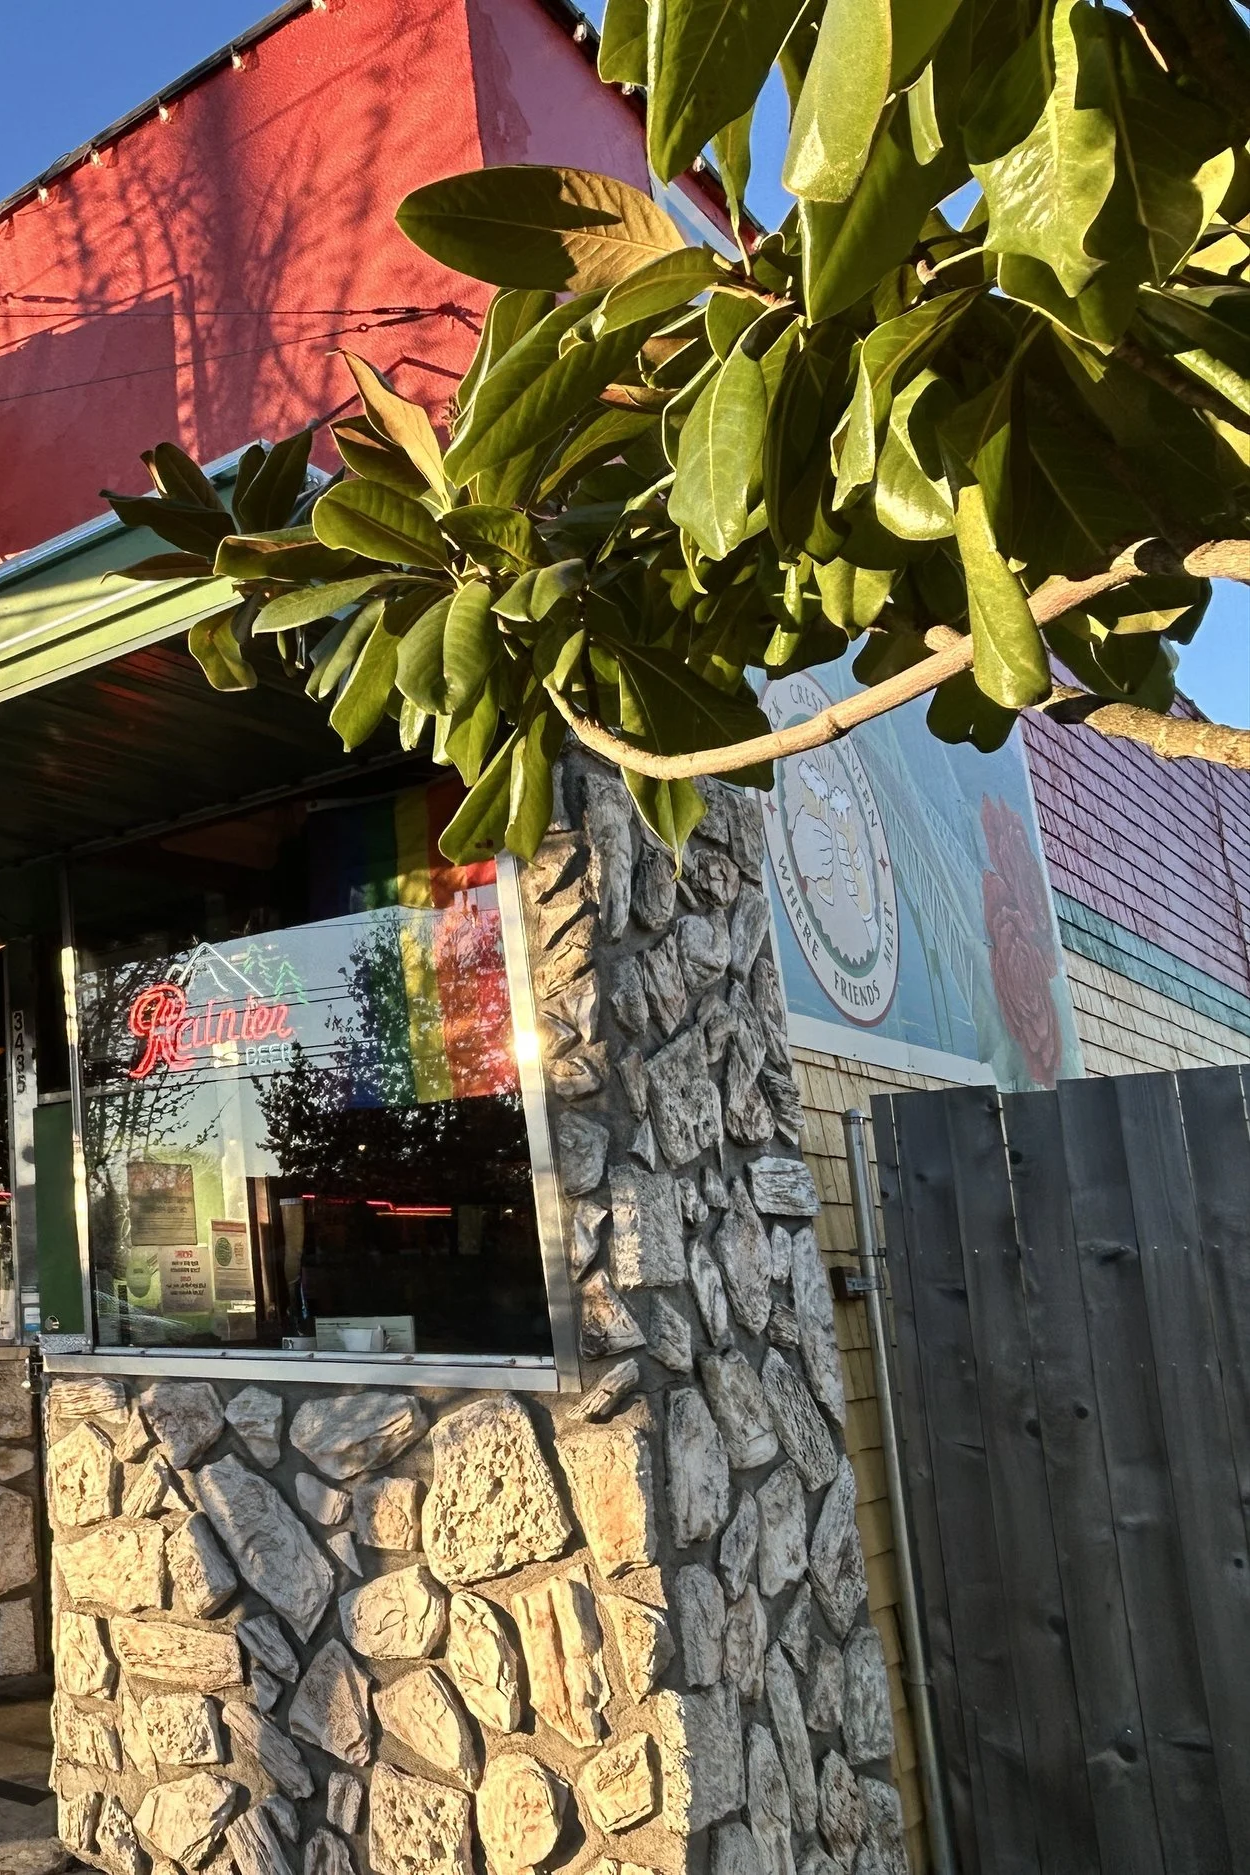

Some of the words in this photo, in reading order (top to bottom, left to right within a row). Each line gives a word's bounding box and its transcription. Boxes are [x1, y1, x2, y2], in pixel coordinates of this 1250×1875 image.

[778, 855, 820, 961] WHERE
[833, 969, 881, 1007] FRIENDS
[883, 901, 894, 971] MEET
[128, 983, 296, 1079] Rainier
[245, 1042, 293, 1066] BEER
